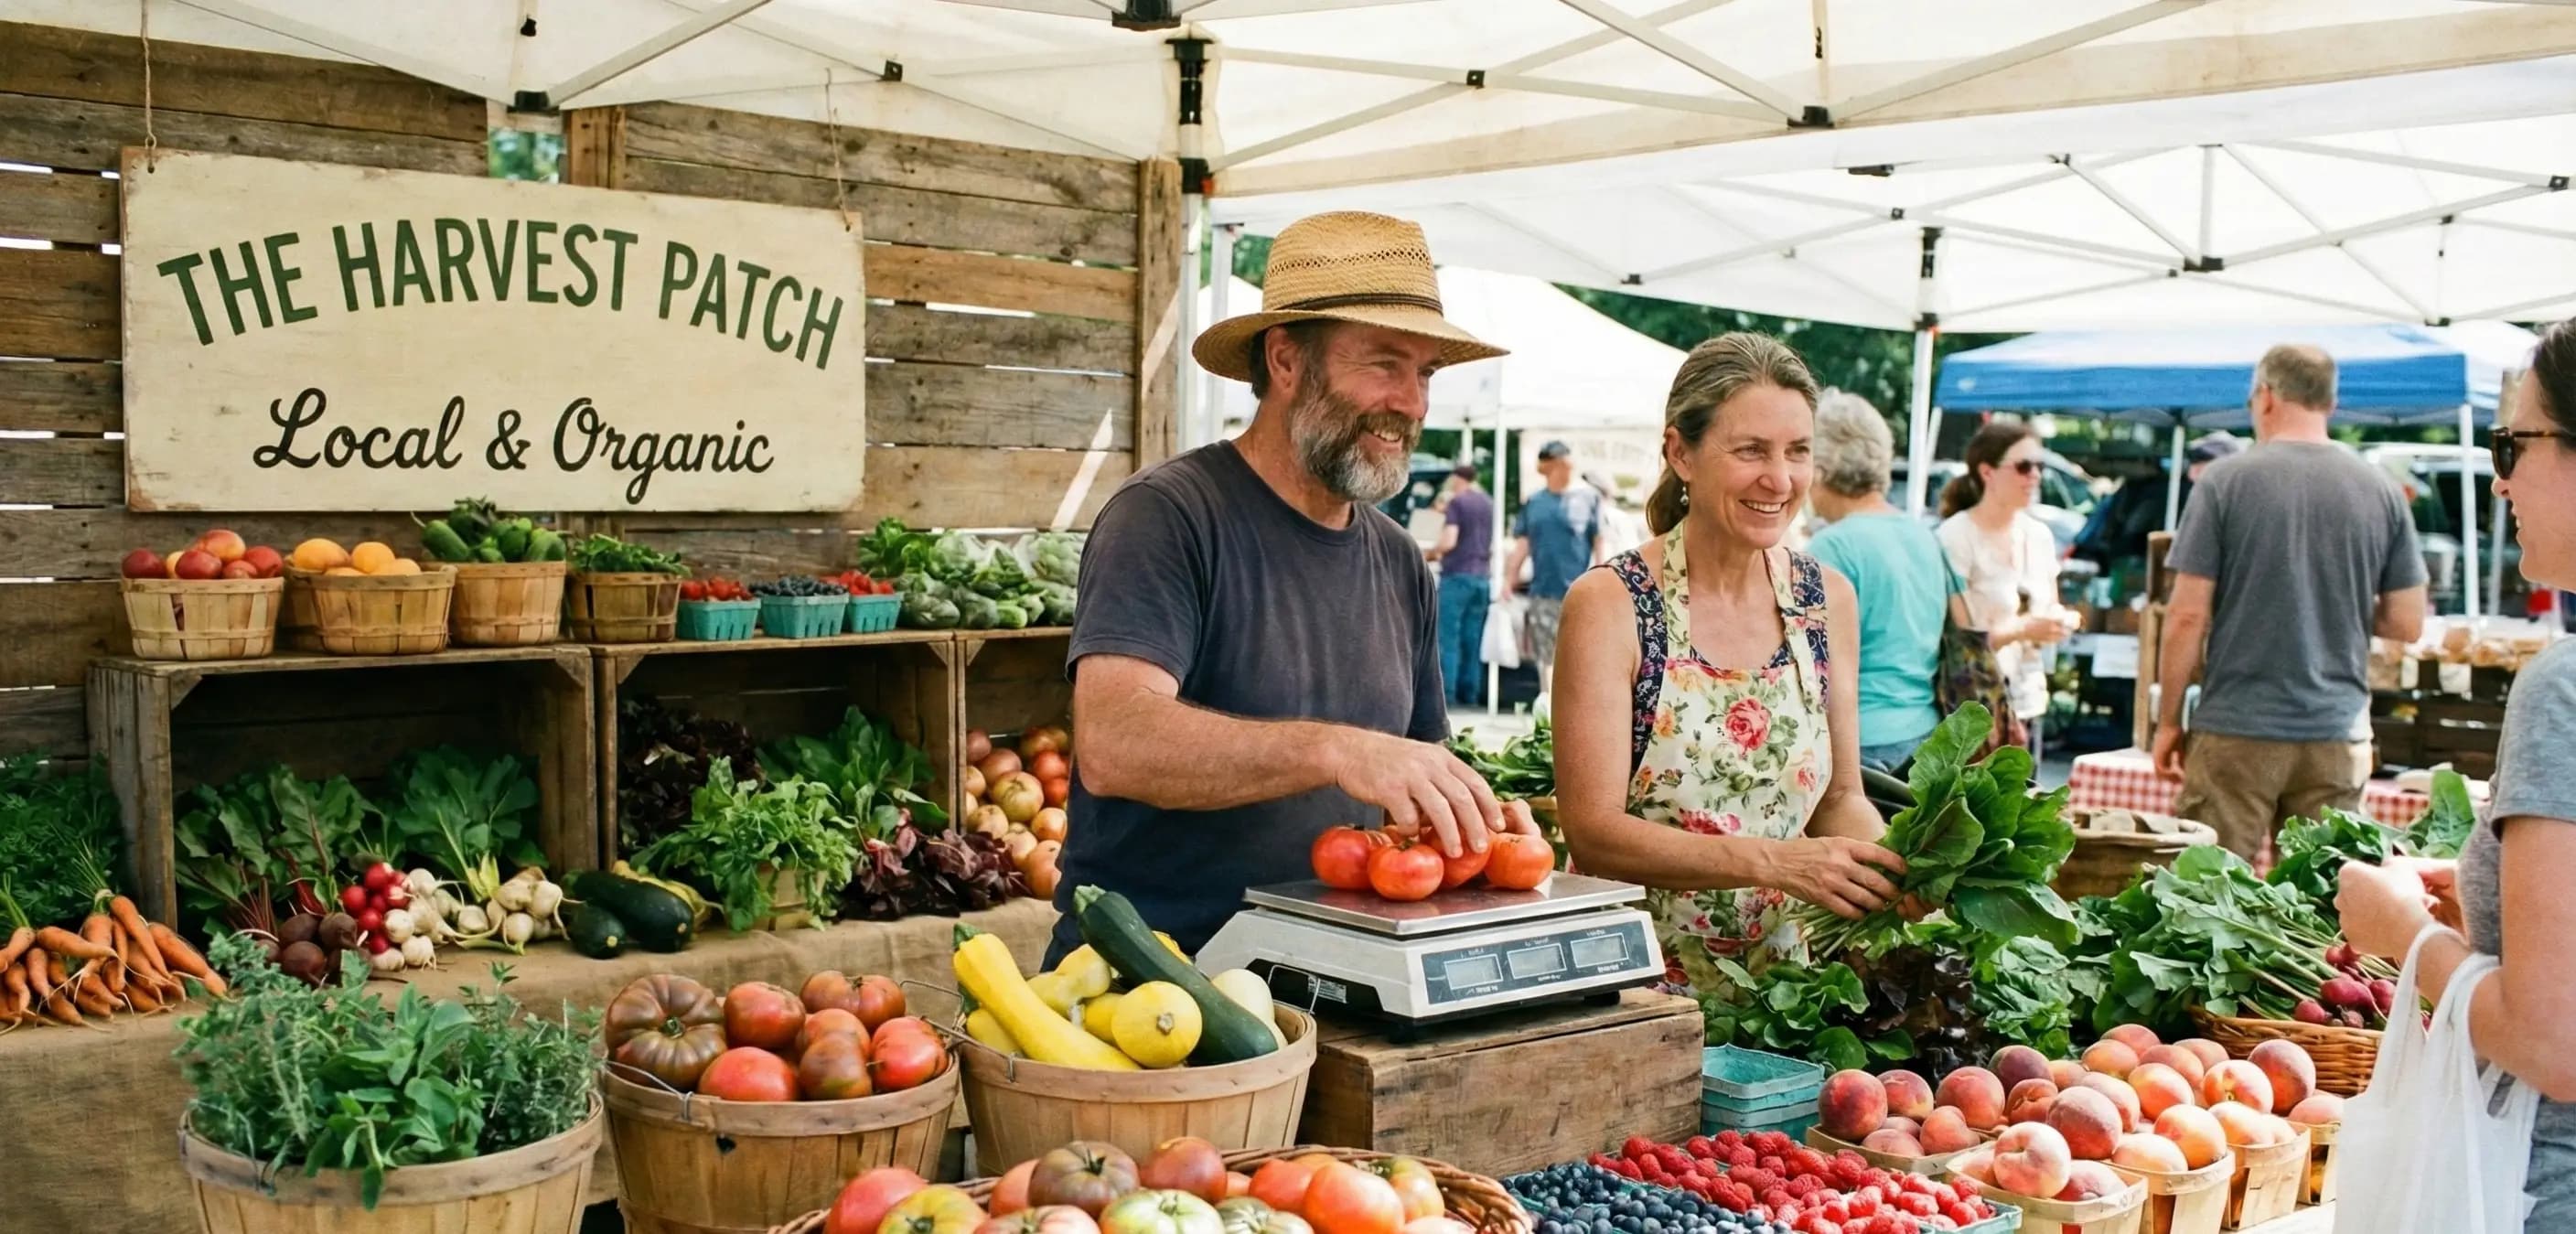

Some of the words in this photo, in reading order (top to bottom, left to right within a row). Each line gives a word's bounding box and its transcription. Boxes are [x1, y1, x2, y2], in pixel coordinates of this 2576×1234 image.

[156, 231, 318, 347] THE
[332, 218, 639, 313] HARVEST
[658, 241, 843, 370] PATCH
[252, 387, 465, 470] Local
[485, 409, 531, 471] &
[553, 397, 775, 506] Organic
